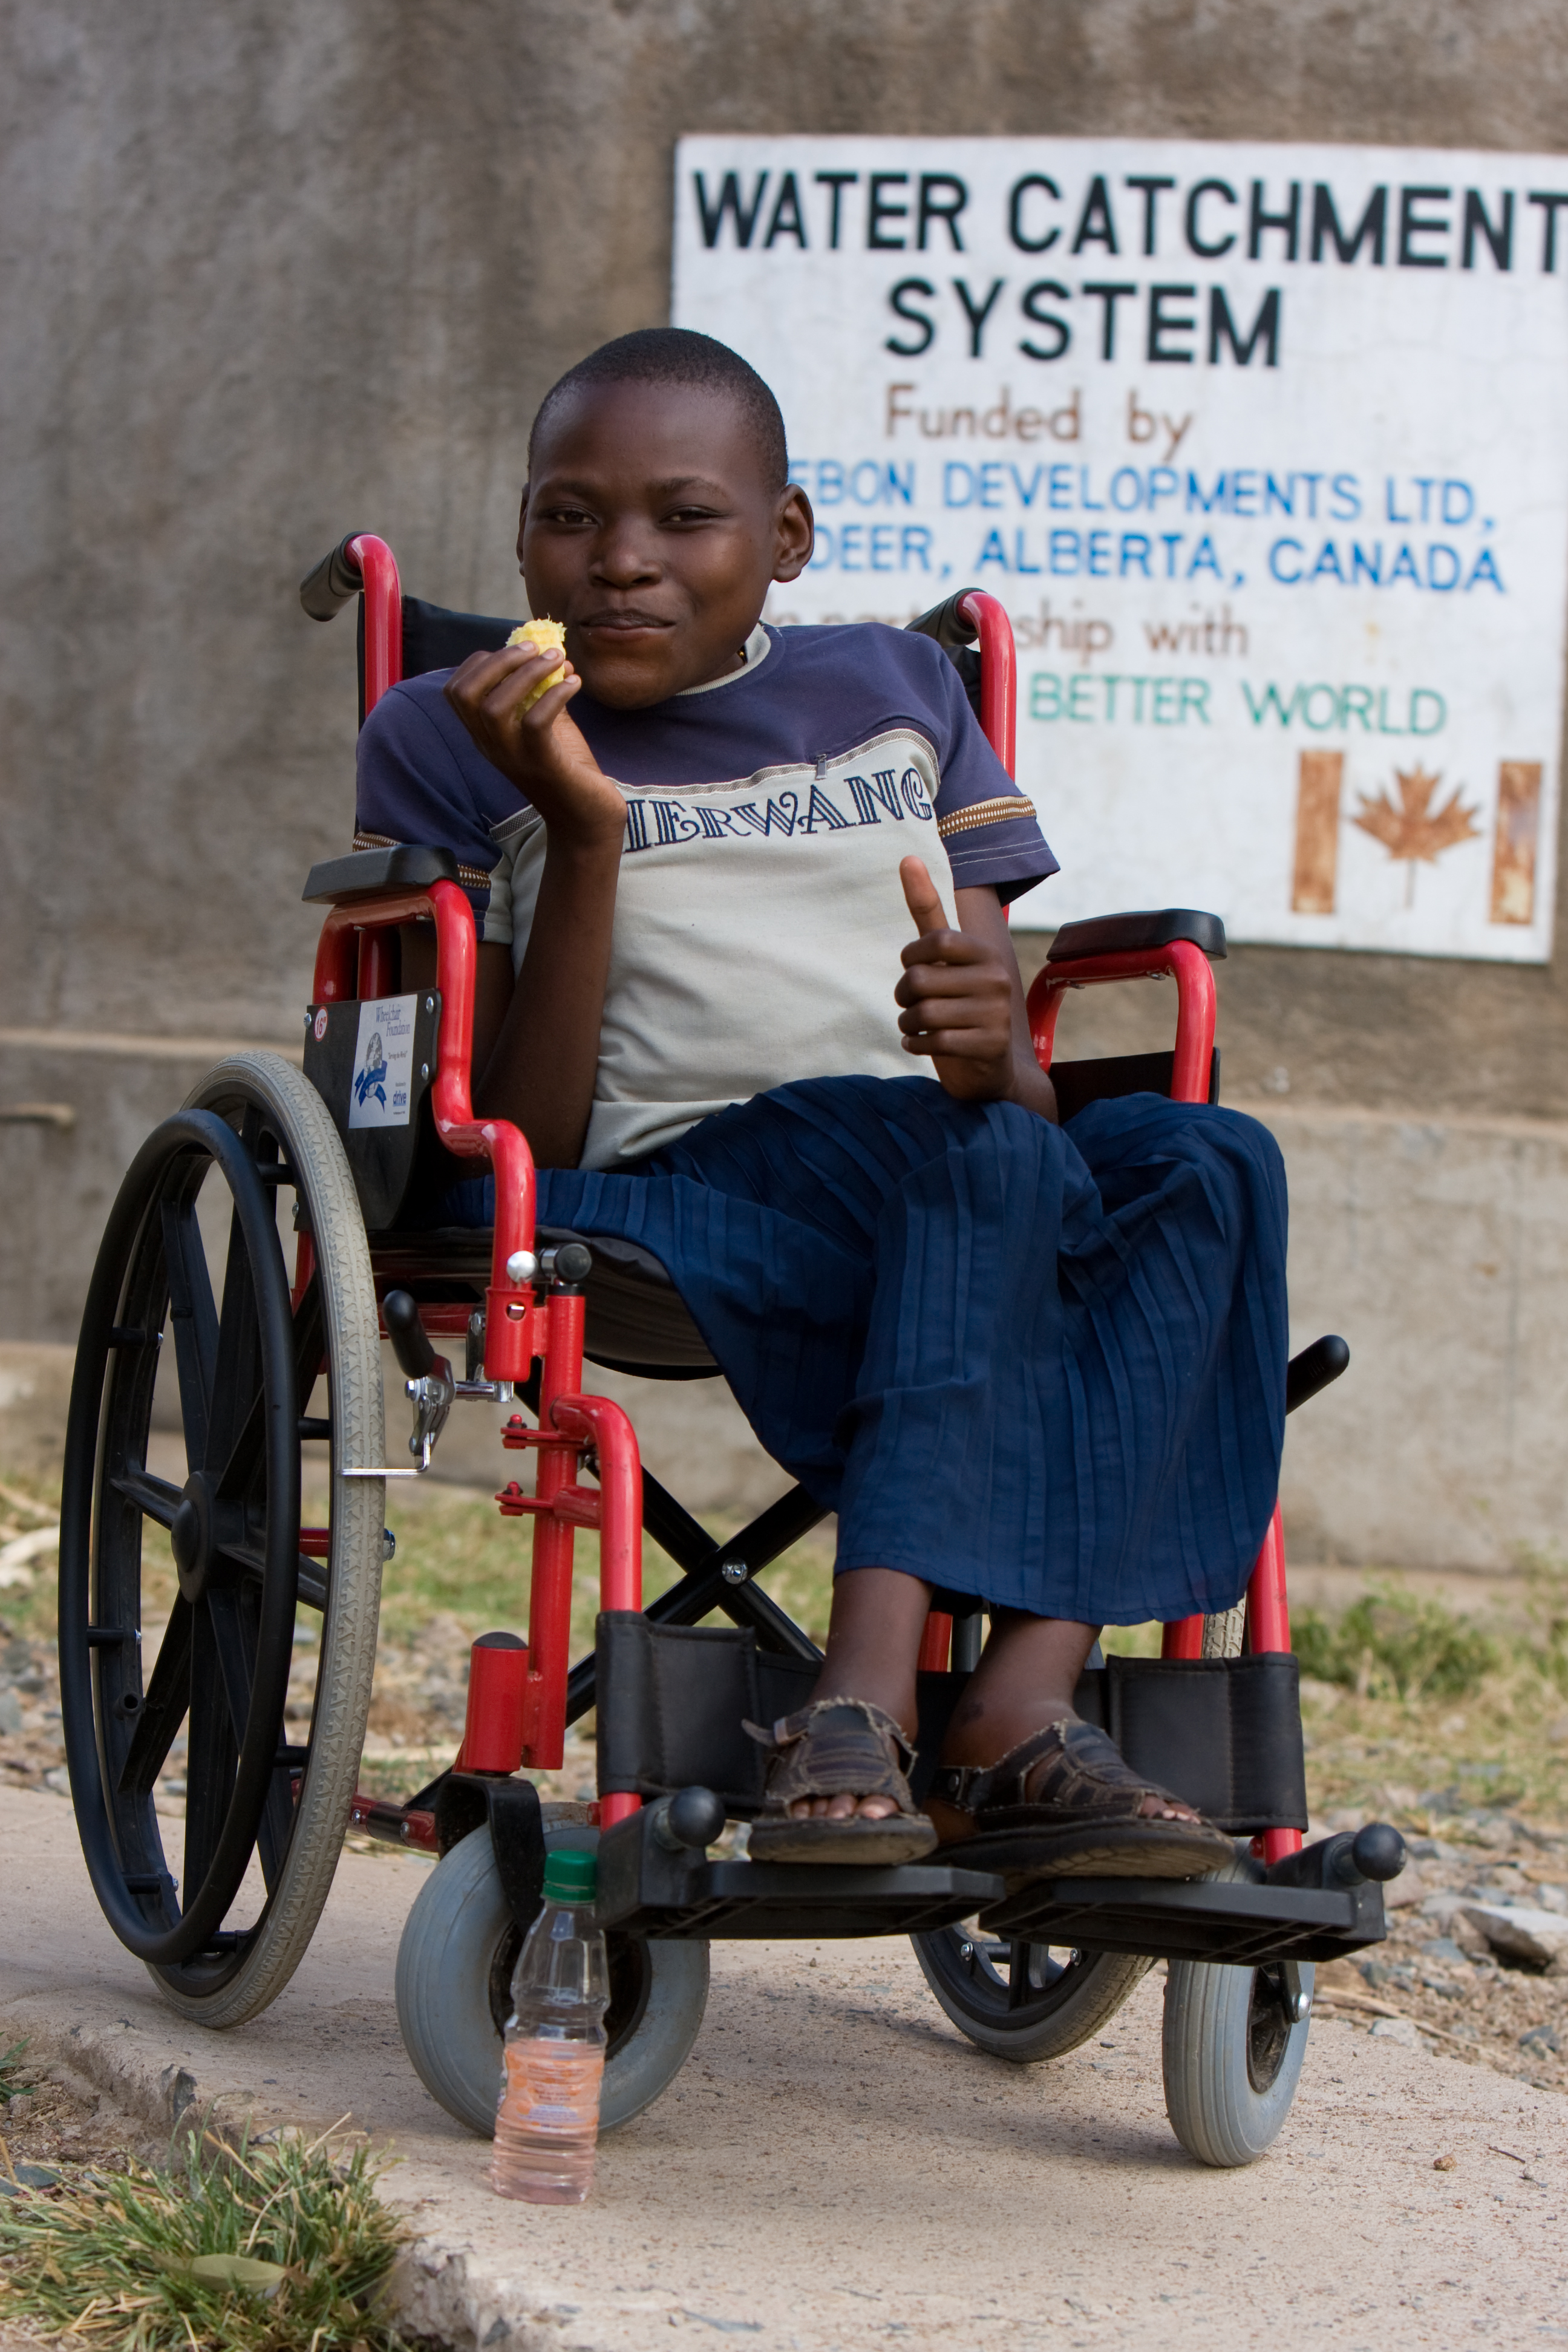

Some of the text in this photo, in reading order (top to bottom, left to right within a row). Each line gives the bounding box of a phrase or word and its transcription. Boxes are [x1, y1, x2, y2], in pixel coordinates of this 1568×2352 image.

[693, 169, 1568, 273] WATER CATCHMENT
[884, 277, 1281, 367] SYSTEM
[886, 383, 1193, 463] Funded by
[944, 461, 1364, 521] DEVELOPMENTS
[807, 524, 1508, 595] DEER, ALBERTA, CANADA
[1144, 604, 1249, 656] with
[1030, 671, 1448, 736] BETTER WORLD
[376, 1004, 401, 1023] Wheelchair
[387, 1020, 411, 1037] Foundation
[393, 1090, 407, 1105] drive
